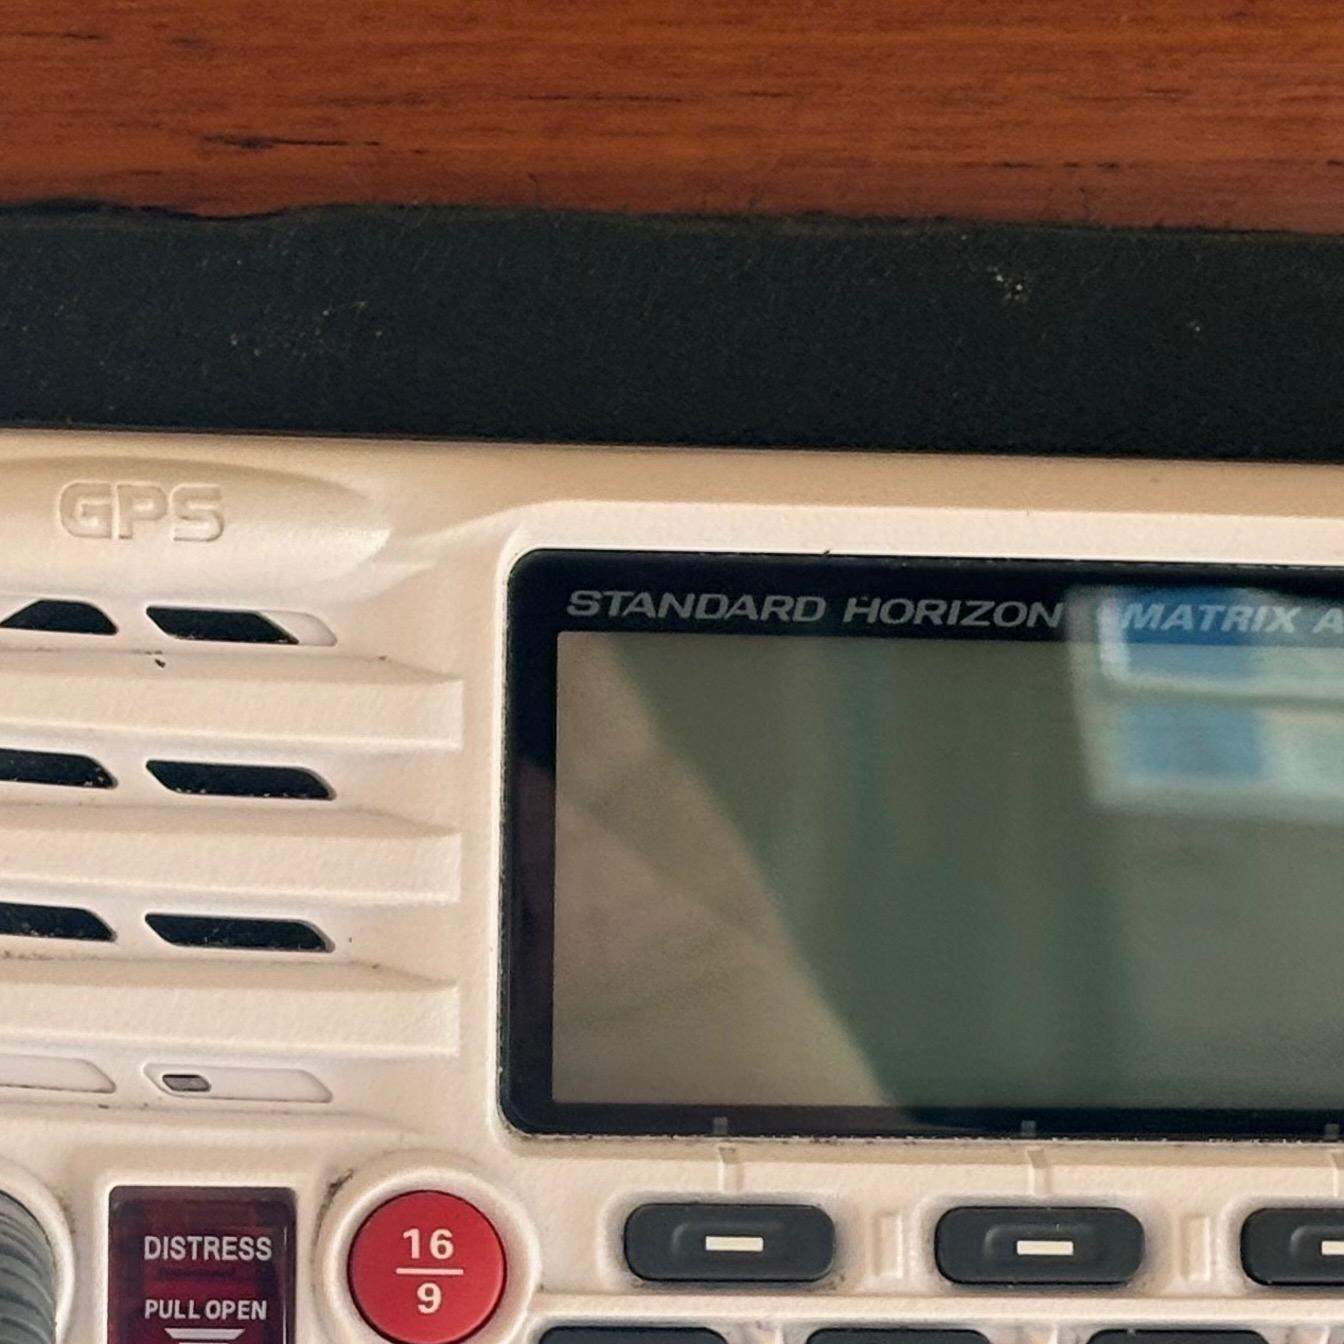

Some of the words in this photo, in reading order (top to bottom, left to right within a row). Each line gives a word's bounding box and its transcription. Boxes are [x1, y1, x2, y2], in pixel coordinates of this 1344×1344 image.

[57, 480, 225, 542] GPS
[566, 588, 826, 624] STANDARD
[842, 594, 1065, 628] HORIZON
[1120, 601, 1302, 634] MATRIX
[143, 1235, 273, 1262] DISTRESS
[402, 1228, 454, 1260] 16
[144, 1299, 201, 1321] PULL
[204, 1300, 268, 1321] OPEN
[416, 1282, 443, 1315] 9
